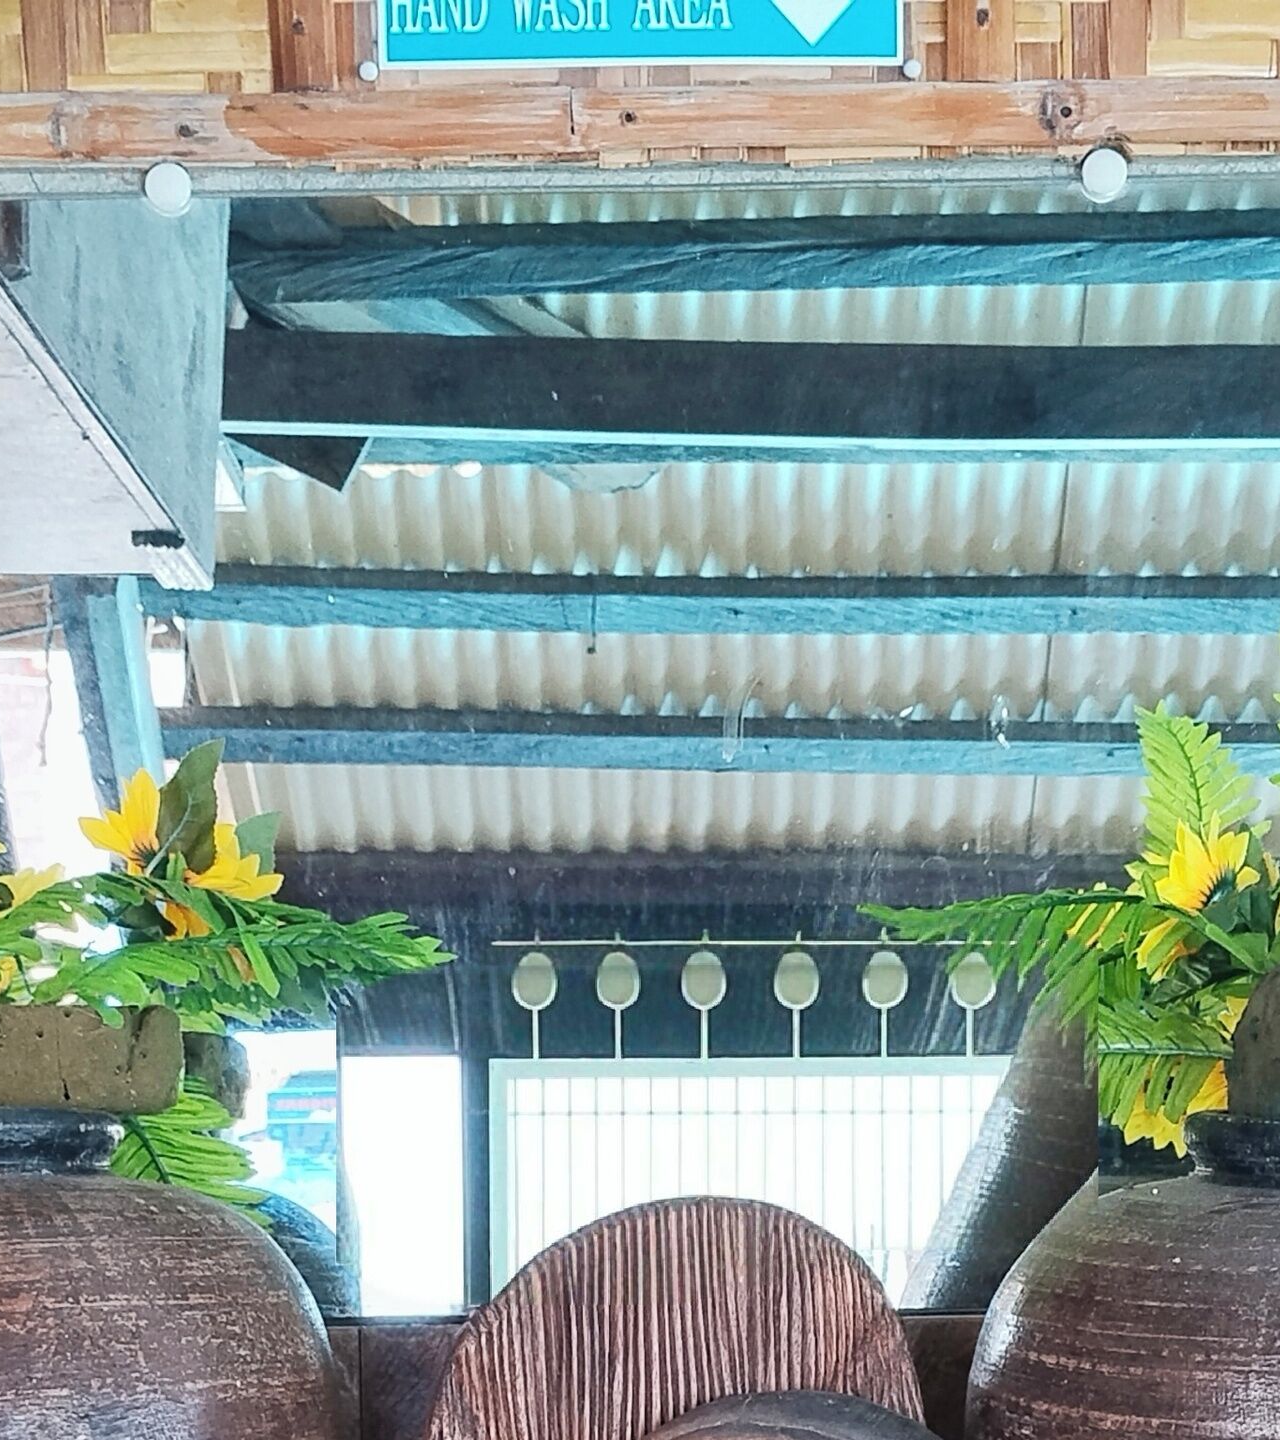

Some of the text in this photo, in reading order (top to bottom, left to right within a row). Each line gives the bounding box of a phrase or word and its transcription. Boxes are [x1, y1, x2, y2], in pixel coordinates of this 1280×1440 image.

[390, 0, 734, 34] HAND WASH AREA
